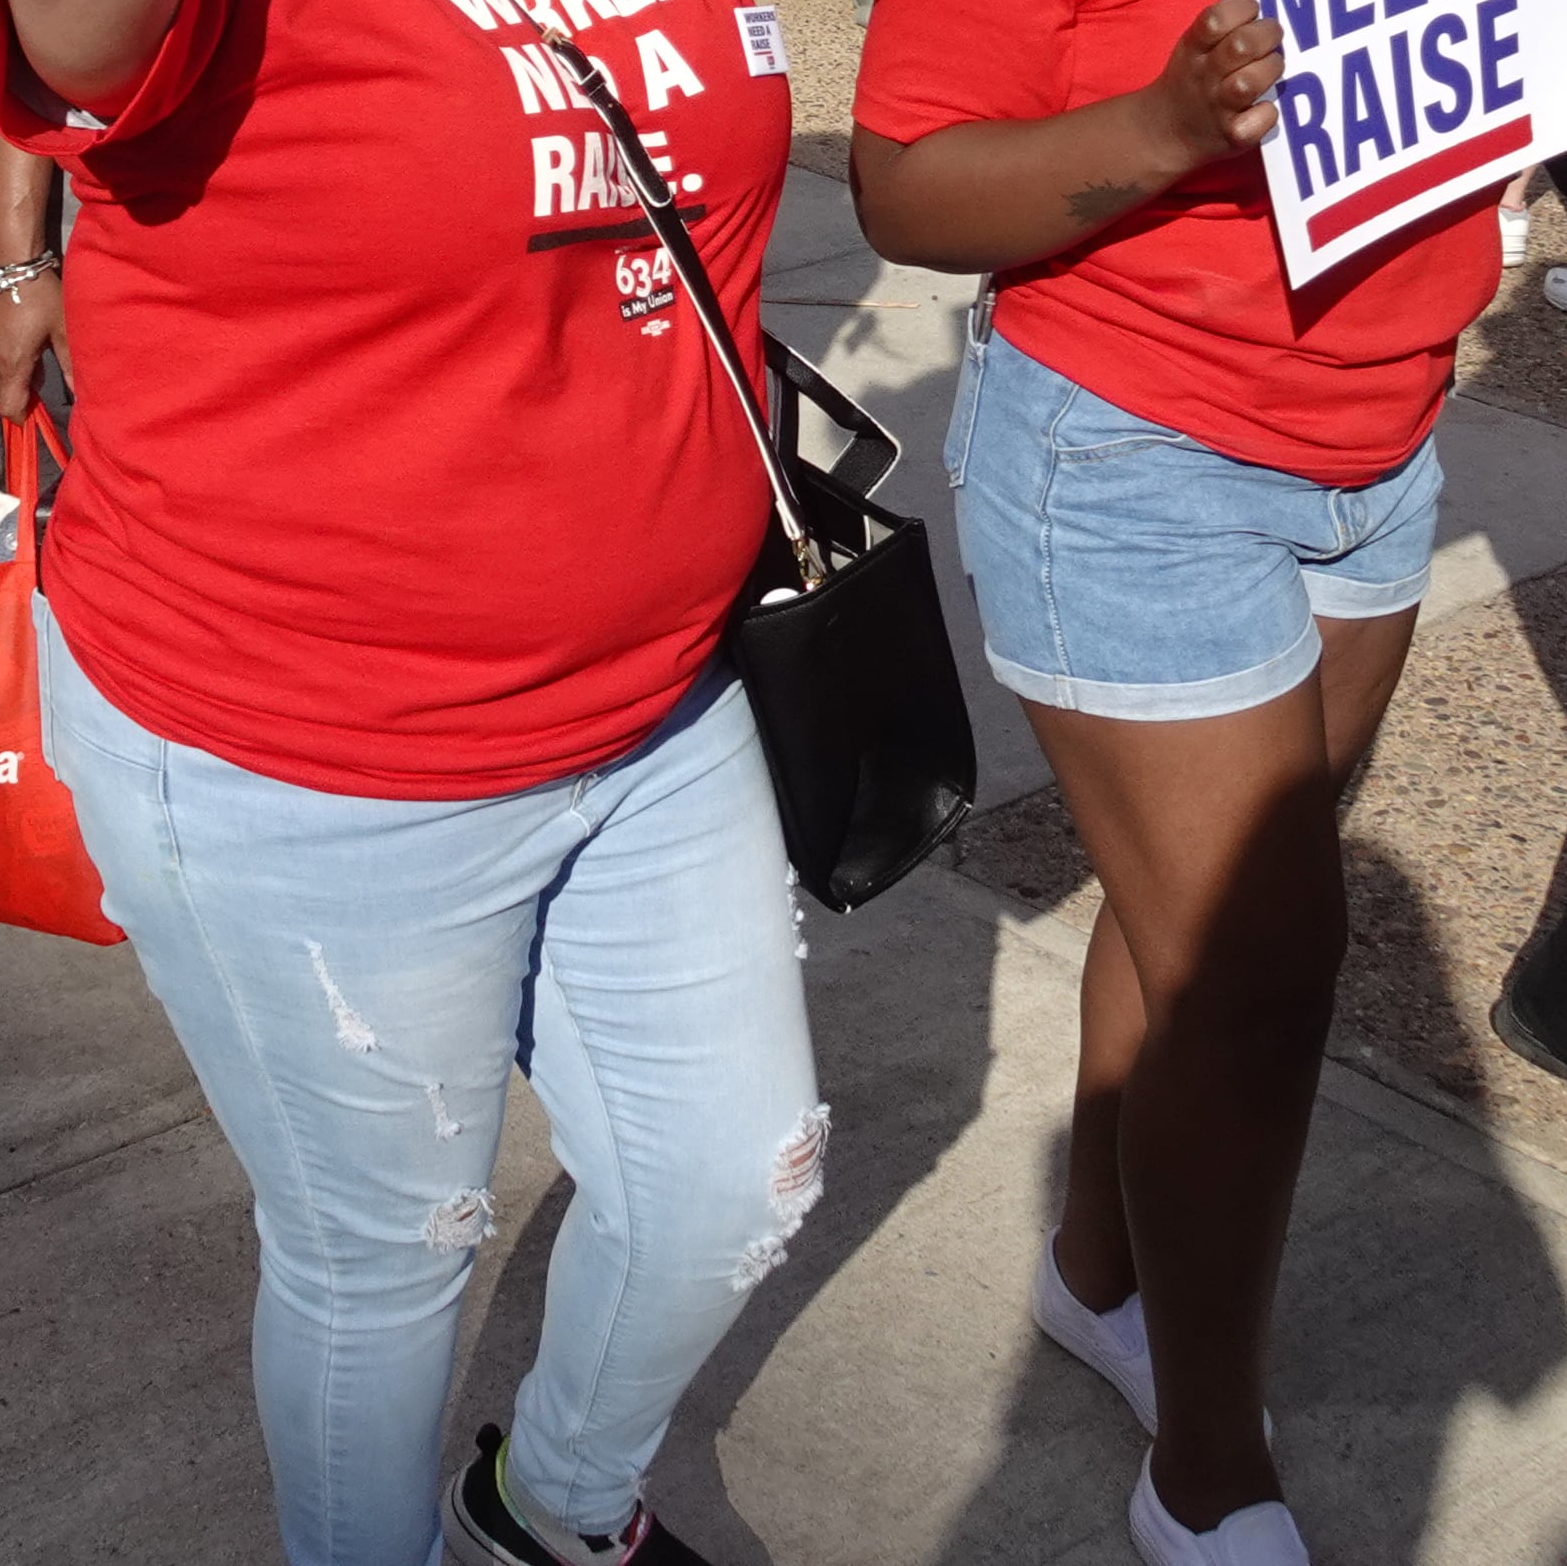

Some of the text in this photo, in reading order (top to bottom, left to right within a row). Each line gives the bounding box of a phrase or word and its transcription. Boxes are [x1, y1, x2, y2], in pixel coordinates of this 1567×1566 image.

[635, 29, 705, 112] A
[615, 247, 673, 298] 634
[620, 292, 674, 318] is My Union
